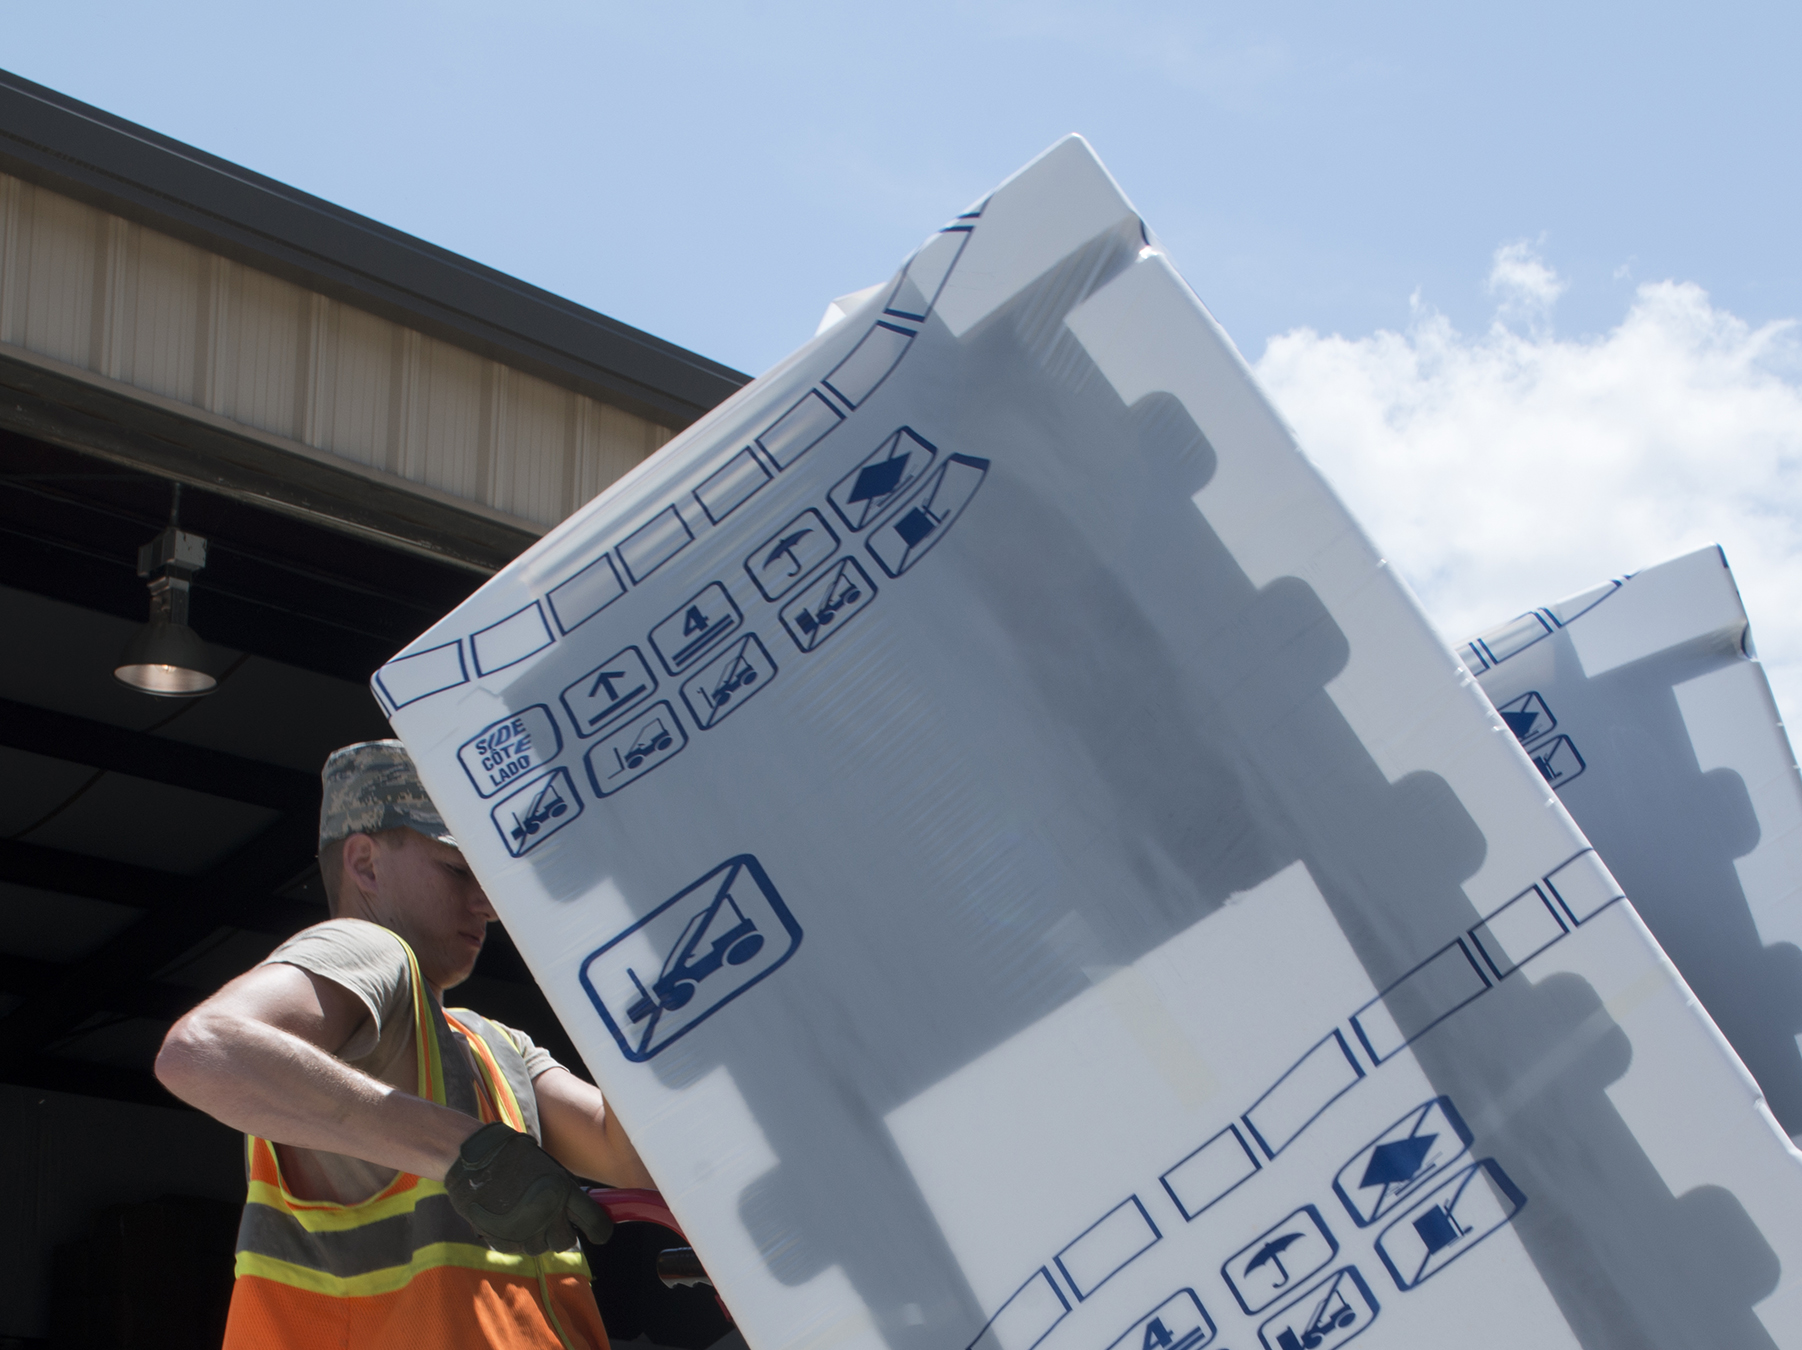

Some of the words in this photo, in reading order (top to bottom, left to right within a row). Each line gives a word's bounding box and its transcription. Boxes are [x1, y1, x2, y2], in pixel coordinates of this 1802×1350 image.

[683, 605, 709, 637] 4
[475, 717, 527, 756] SIDE
[481, 733, 532, 772] CÔTE
[489, 754, 531, 788] LADO
